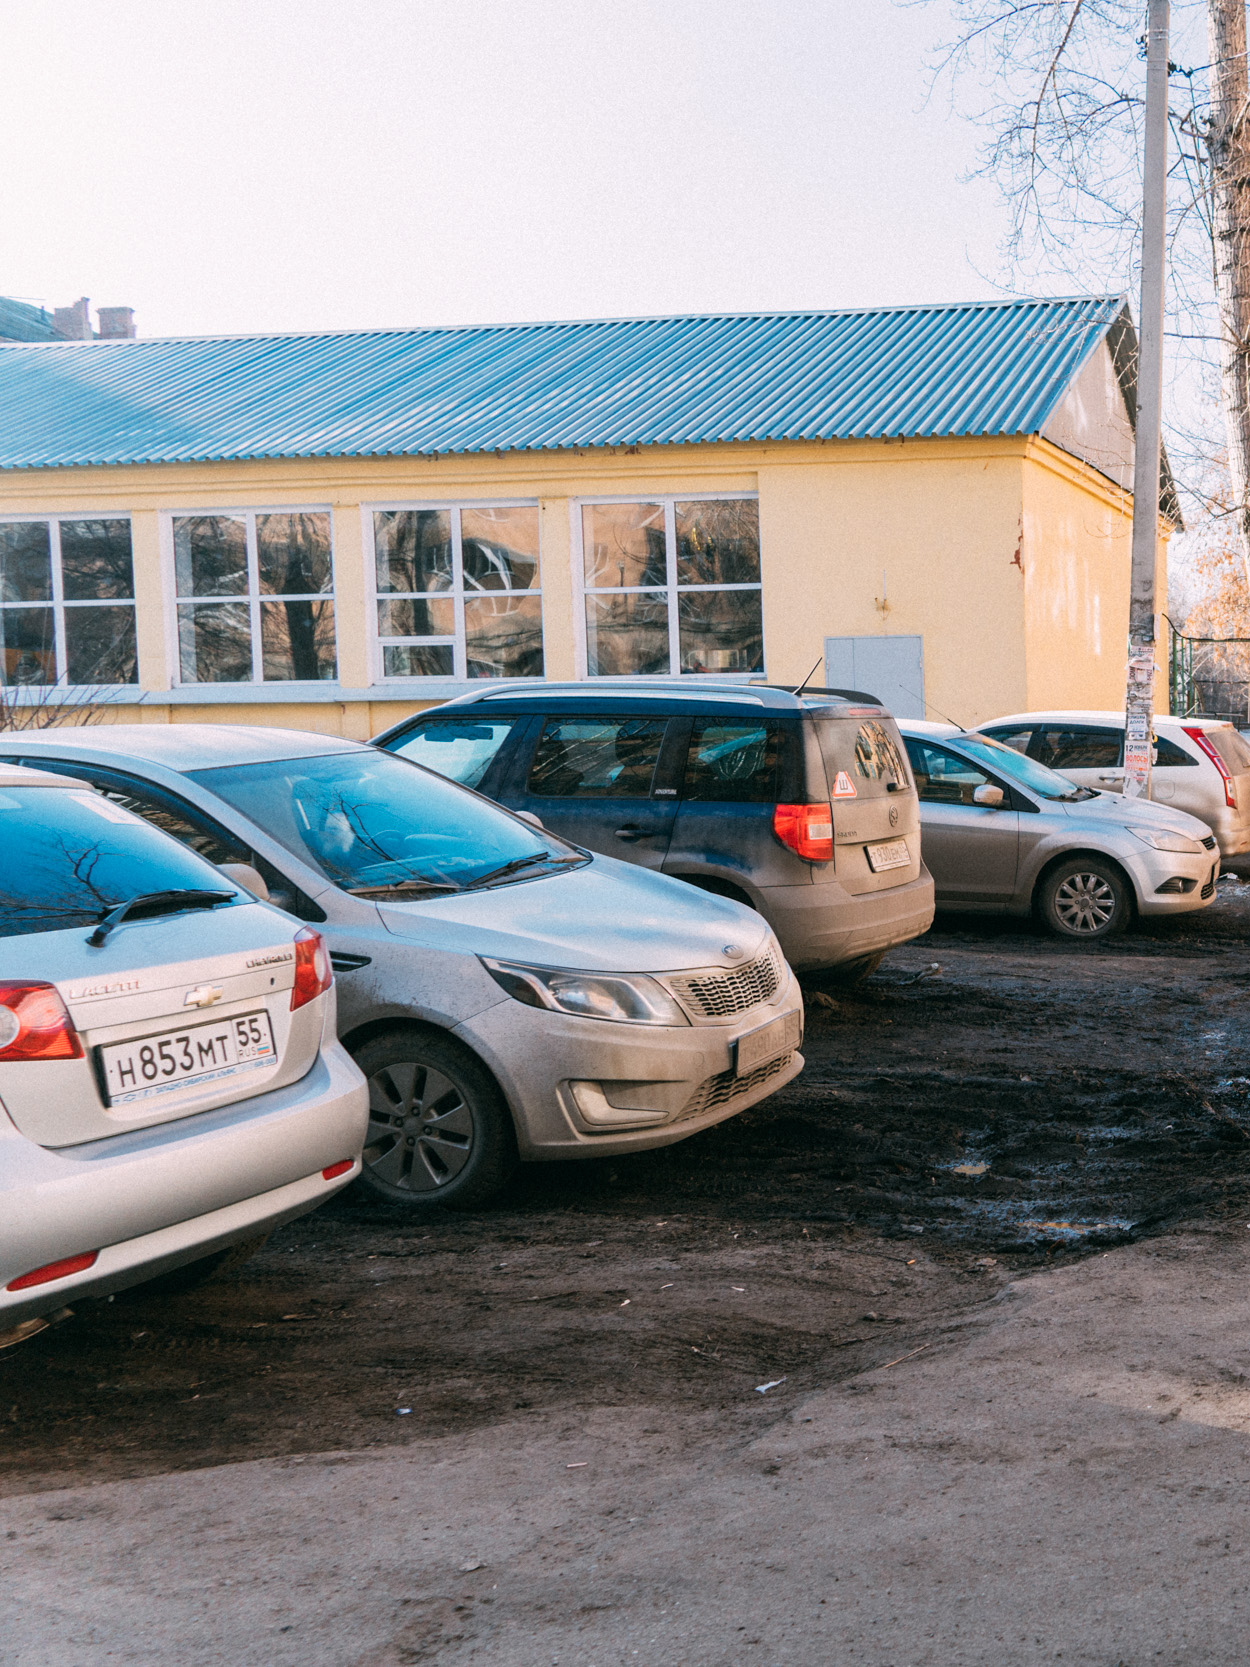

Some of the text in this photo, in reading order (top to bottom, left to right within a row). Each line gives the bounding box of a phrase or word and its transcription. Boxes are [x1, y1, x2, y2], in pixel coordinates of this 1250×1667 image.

[1125, 744, 1134, 752] 12
[1125, 754, 1149, 763] ВОЛОСЫ
[839, 779, 849, 791] Ш
[236, 1017, 262, 1047] 55
[239, 1047, 258, 1058] RUS
